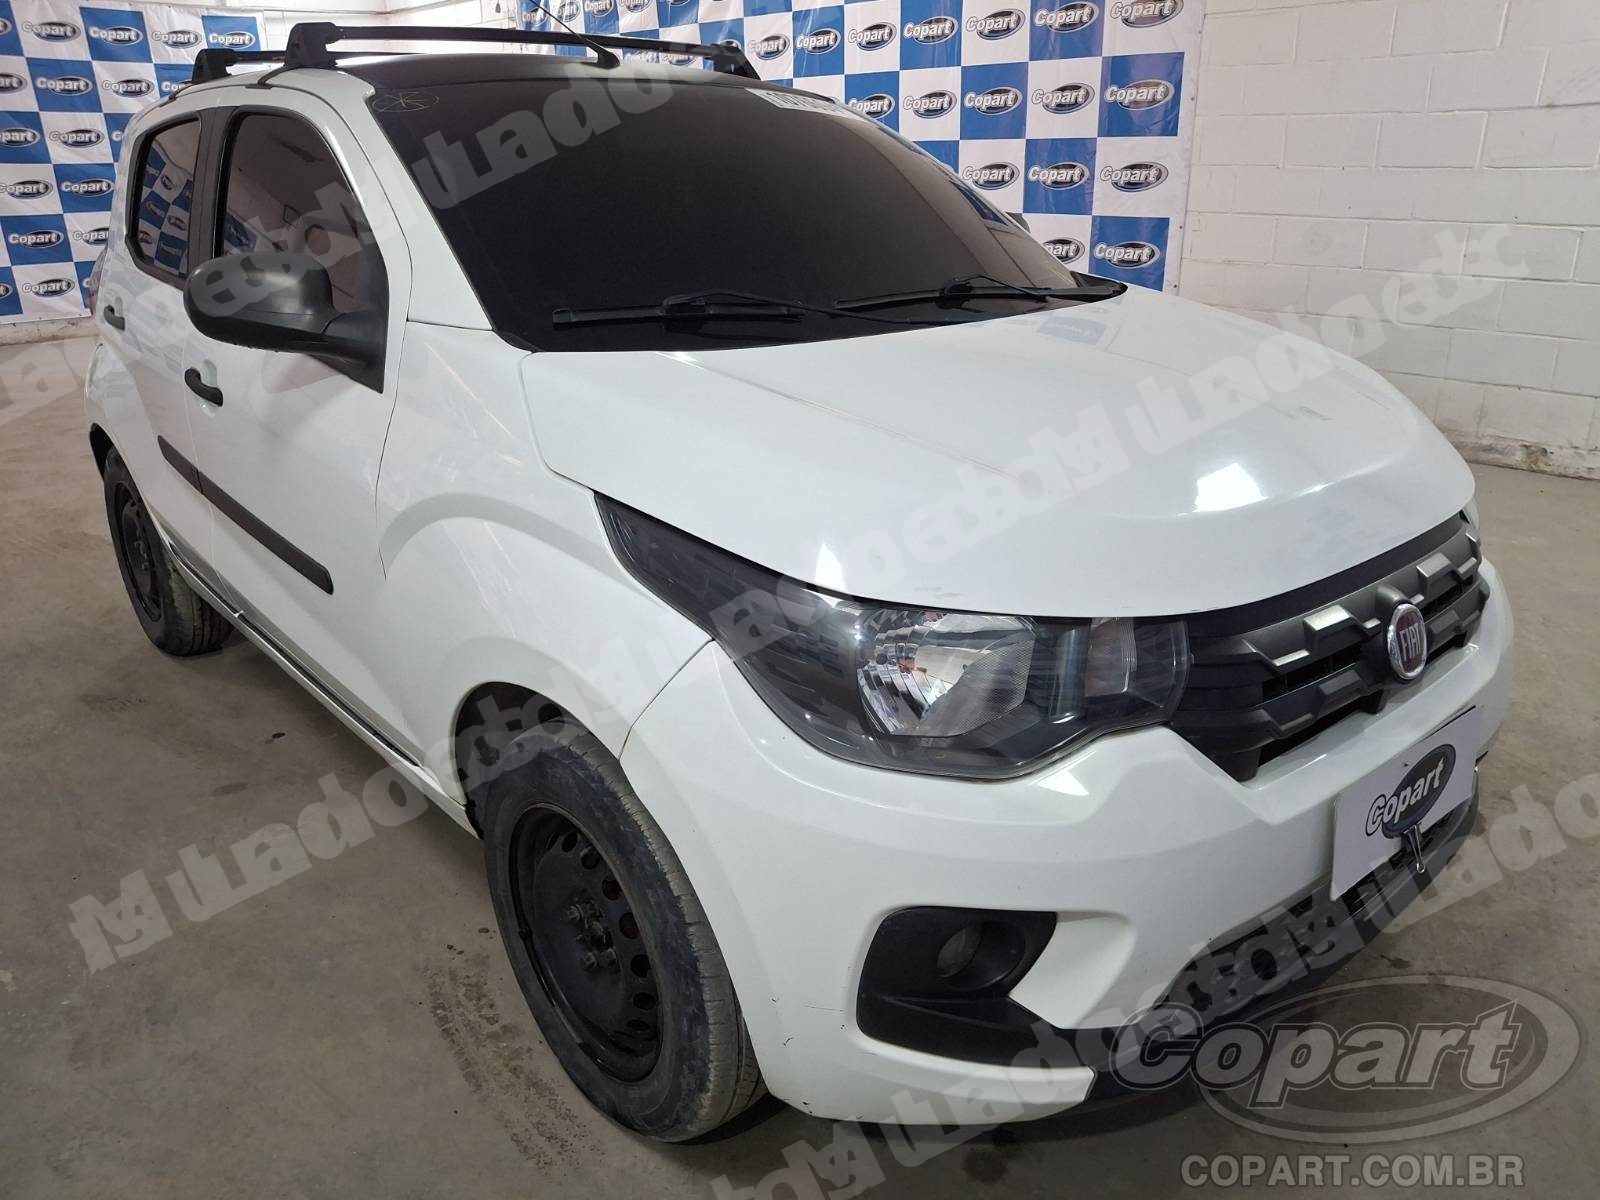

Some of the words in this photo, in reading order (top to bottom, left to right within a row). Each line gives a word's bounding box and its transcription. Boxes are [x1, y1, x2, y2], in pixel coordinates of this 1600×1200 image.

[1035, 6, 1090, 29] Copart
[1111, 0, 1173, 22] Copart
[23, 22, 73, 39] Copart
[89, 27, 137, 44] Copart
[848, 26, 891, 45] Copart
[903, 20, 953, 41] Copart
[966, 14, 1018, 36] Copart
[152, 30, 196, 47] Copart
[209, 32, 252, 49] Copart
[749, 37, 786, 56] Copart
[797, 32, 836, 53] Copart
[36, 77, 86, 92] Copart
[102, 80, 149, 95] Copart
[1104, 80, 1165, 103] Copart
[848, 97, 890, 116] Copart
[903, 93, 951, 114] Copart
[965, 89, 1017, 111] Copart
[1032, 86, 1086, 110] Copart
[50, 130, 97, 145] Copart
[963, 163, 1014, 186] Copart
[1028, 163, 1082, 186] Copart
[1101, 163, 1161, 187] Copart
[61, 180, 107, 196] Copart
[9, 231, 57, 248] Copart
[1046, 240, 1077, 258] part
[1095, 240, 1152, 265] Copart
[22, 279, 72, 296] Copart
[1400, 623, 1422, 662] FIAT
[1366, 757, 1444, 836] Copart
